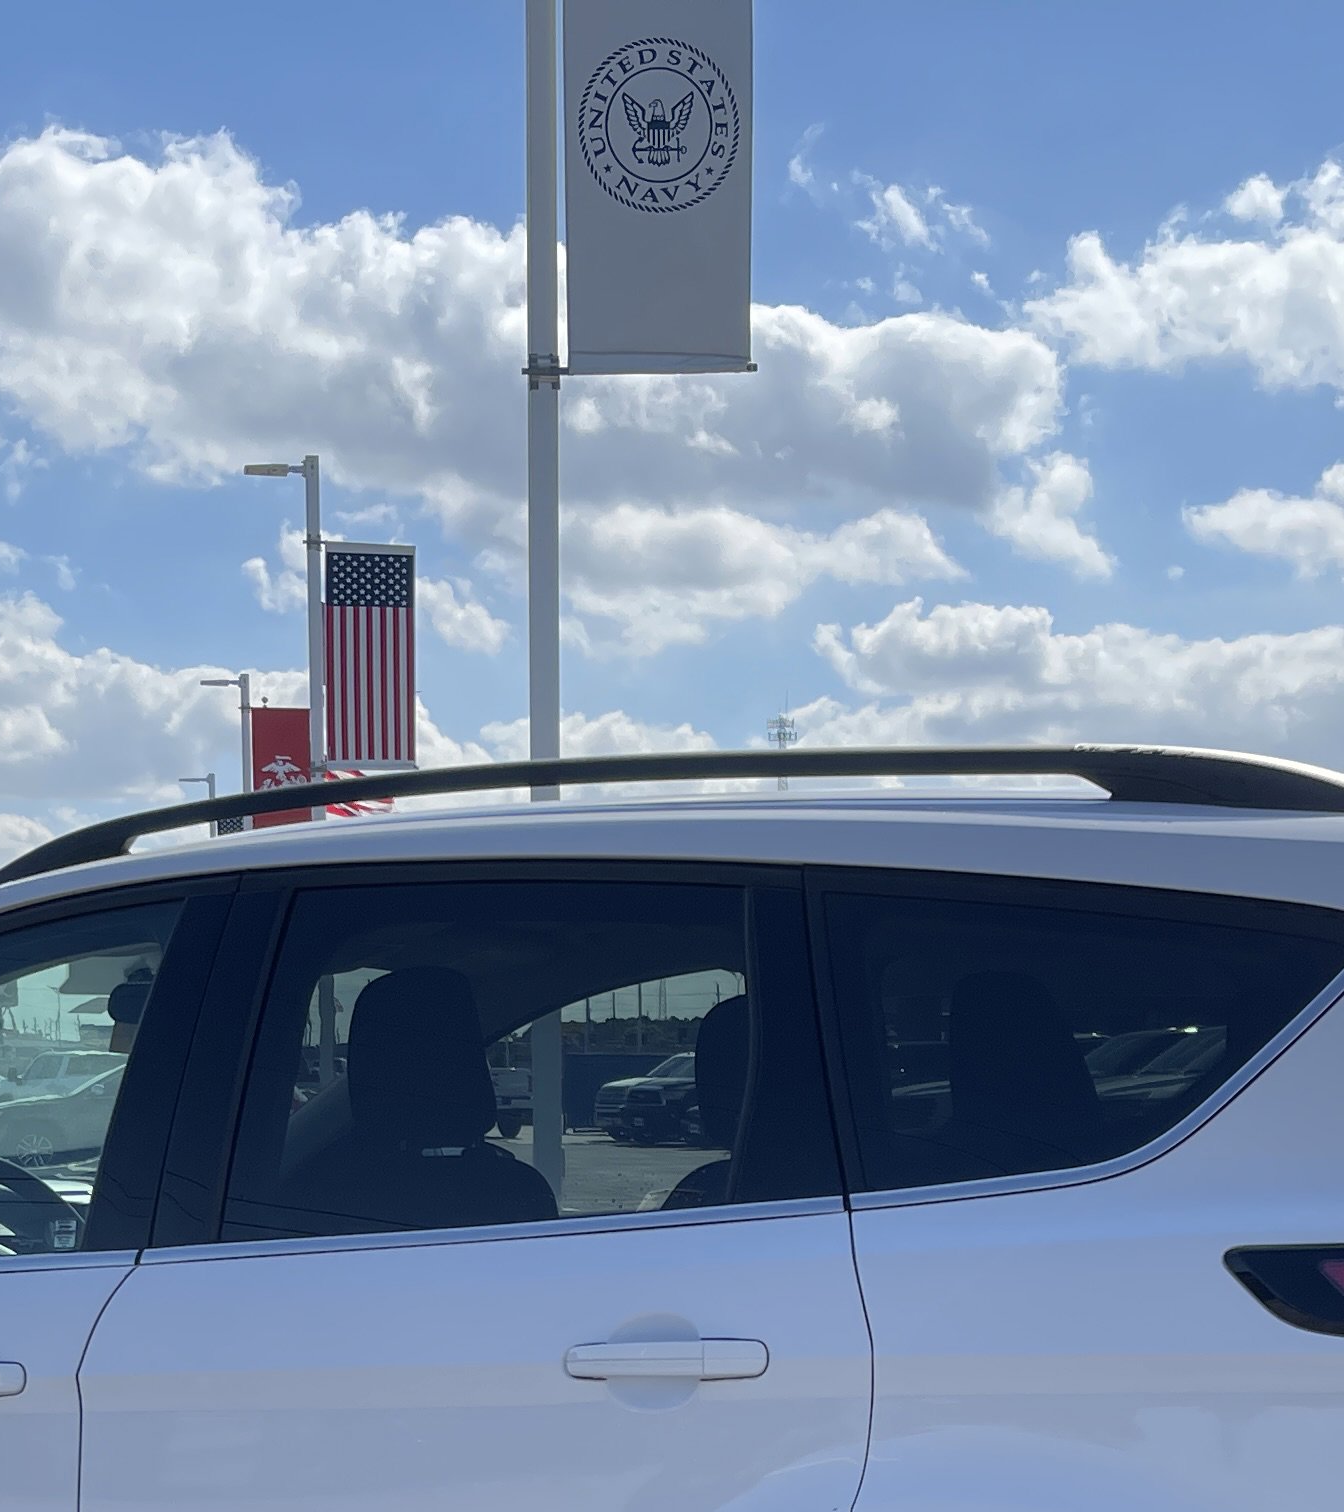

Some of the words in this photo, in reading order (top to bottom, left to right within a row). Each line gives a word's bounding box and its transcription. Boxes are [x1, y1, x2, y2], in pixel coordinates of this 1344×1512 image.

[588, 48, 657, 158] UNITED
[666, 49, 729, 160] STATES
[615, 173, 703, 203] NAVY
